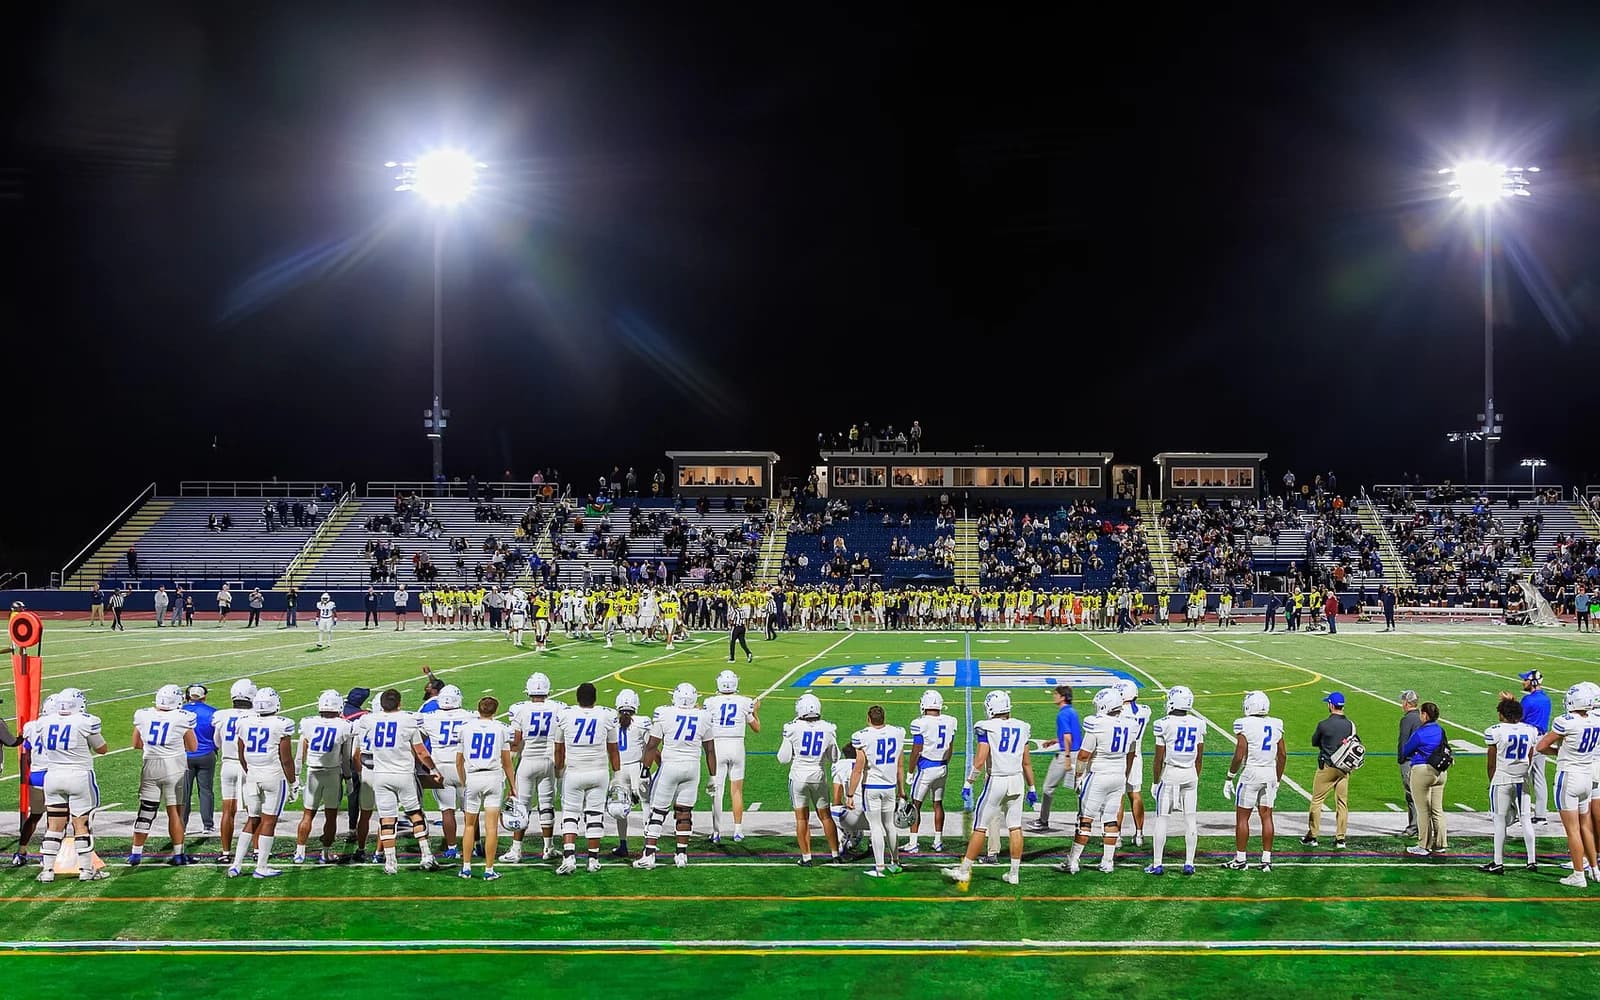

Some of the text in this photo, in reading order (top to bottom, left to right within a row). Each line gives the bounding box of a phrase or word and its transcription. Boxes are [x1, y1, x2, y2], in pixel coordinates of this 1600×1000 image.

[528, 711, 553, 737] 53
[719, 703, 737, 726] 12
[47, 724, 72, 751] 64
[148, 721, 170, 746] 51
[247, 727, 270, 753] 52
[310, 726, 337, 752] 20
[374, 721, 398, 748] 69
[573, 718, 598, 744] 74
[674, 715, 698, 742] 75
[937, 725, 946, 749] 5
[998, 726, 1021, 753] 87
[1110, 726, 1129, 752] 61
[1174, 726, 1197, 752] 85
[1261, 725, 1272, 751] 2
[1578, 727, 1600, 753] 88
[469, 732, 496, 759] 98
[800, 731, 824, 756] 96
[875, 737, 897, 765] 92
[1505, 734, 1529, 760] 26
